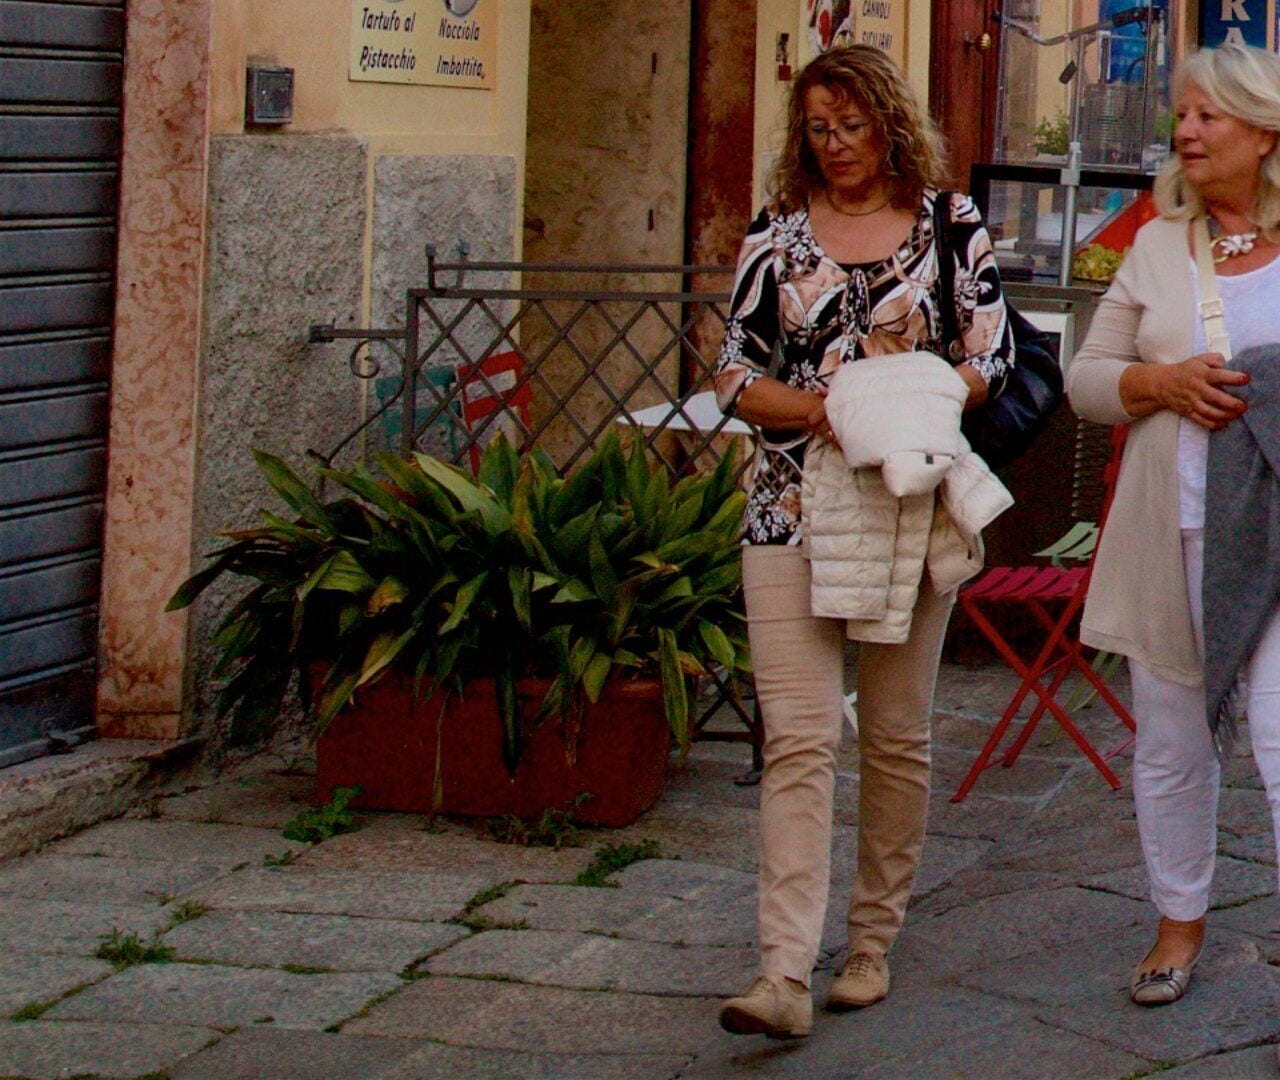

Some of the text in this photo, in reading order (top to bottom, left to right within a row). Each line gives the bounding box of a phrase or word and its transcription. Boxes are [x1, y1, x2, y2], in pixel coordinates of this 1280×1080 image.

[362, 7, 416, 33] Tartufo al
[439, 17, 480, 41] Nocciola
[359, 45, 416, 70] Pistacchio
[436, 55, 484, 77] Imbottita
